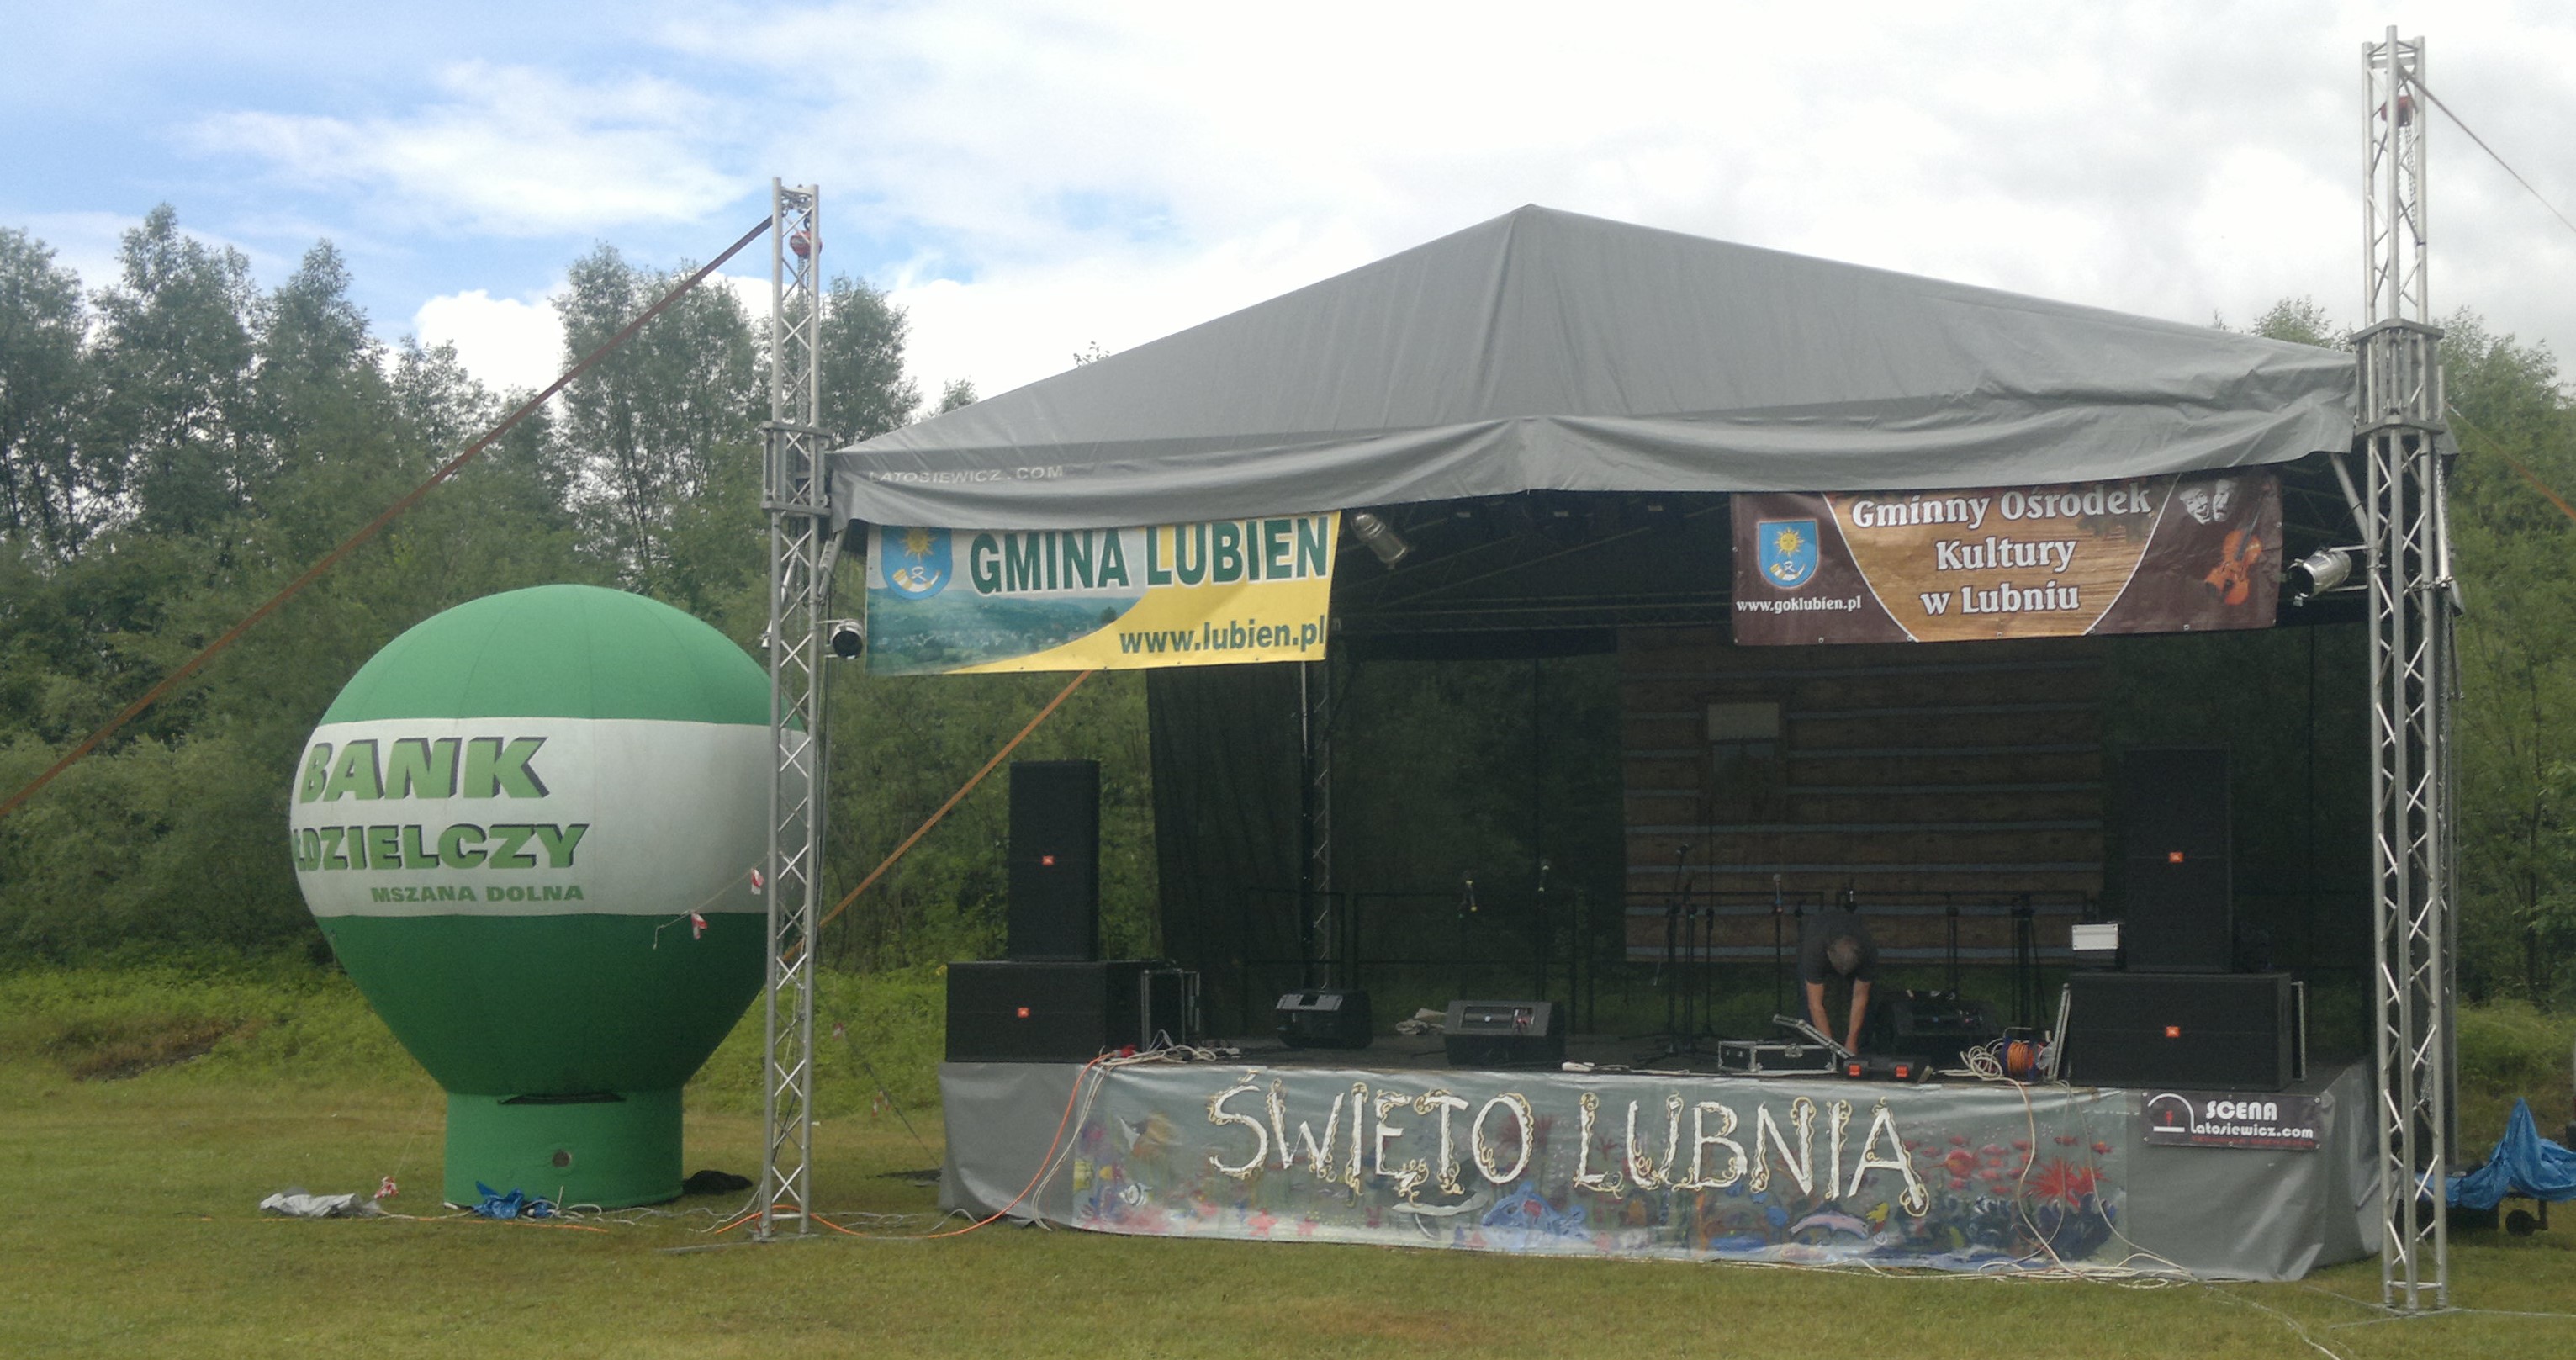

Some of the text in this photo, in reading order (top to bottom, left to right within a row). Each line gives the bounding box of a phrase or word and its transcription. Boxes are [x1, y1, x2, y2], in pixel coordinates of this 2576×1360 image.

[1851, 484, 2152, 530] Gminny Ośrodek
[970, 527, 1129, 595] GMINA
[1935, 537, 2076, 574] Kultury
[1735, 595, 1862, 615] www.goklubien.pl
[1920, 580, 2080, 616] w Lubniu
[1119, 615, 1325, 655] www.lubien.pl
[299, 736, 550, 804] BANK
[370, 885, 584, 903] MSZANA DOLNA
[2205, 1100, 2278, 1121] SCENA
[1206, 1069, 1931, 1219] ŚWIĘTO LUBNIA
[2190, 1121, 2314, 1139] Latosiewicz.com
